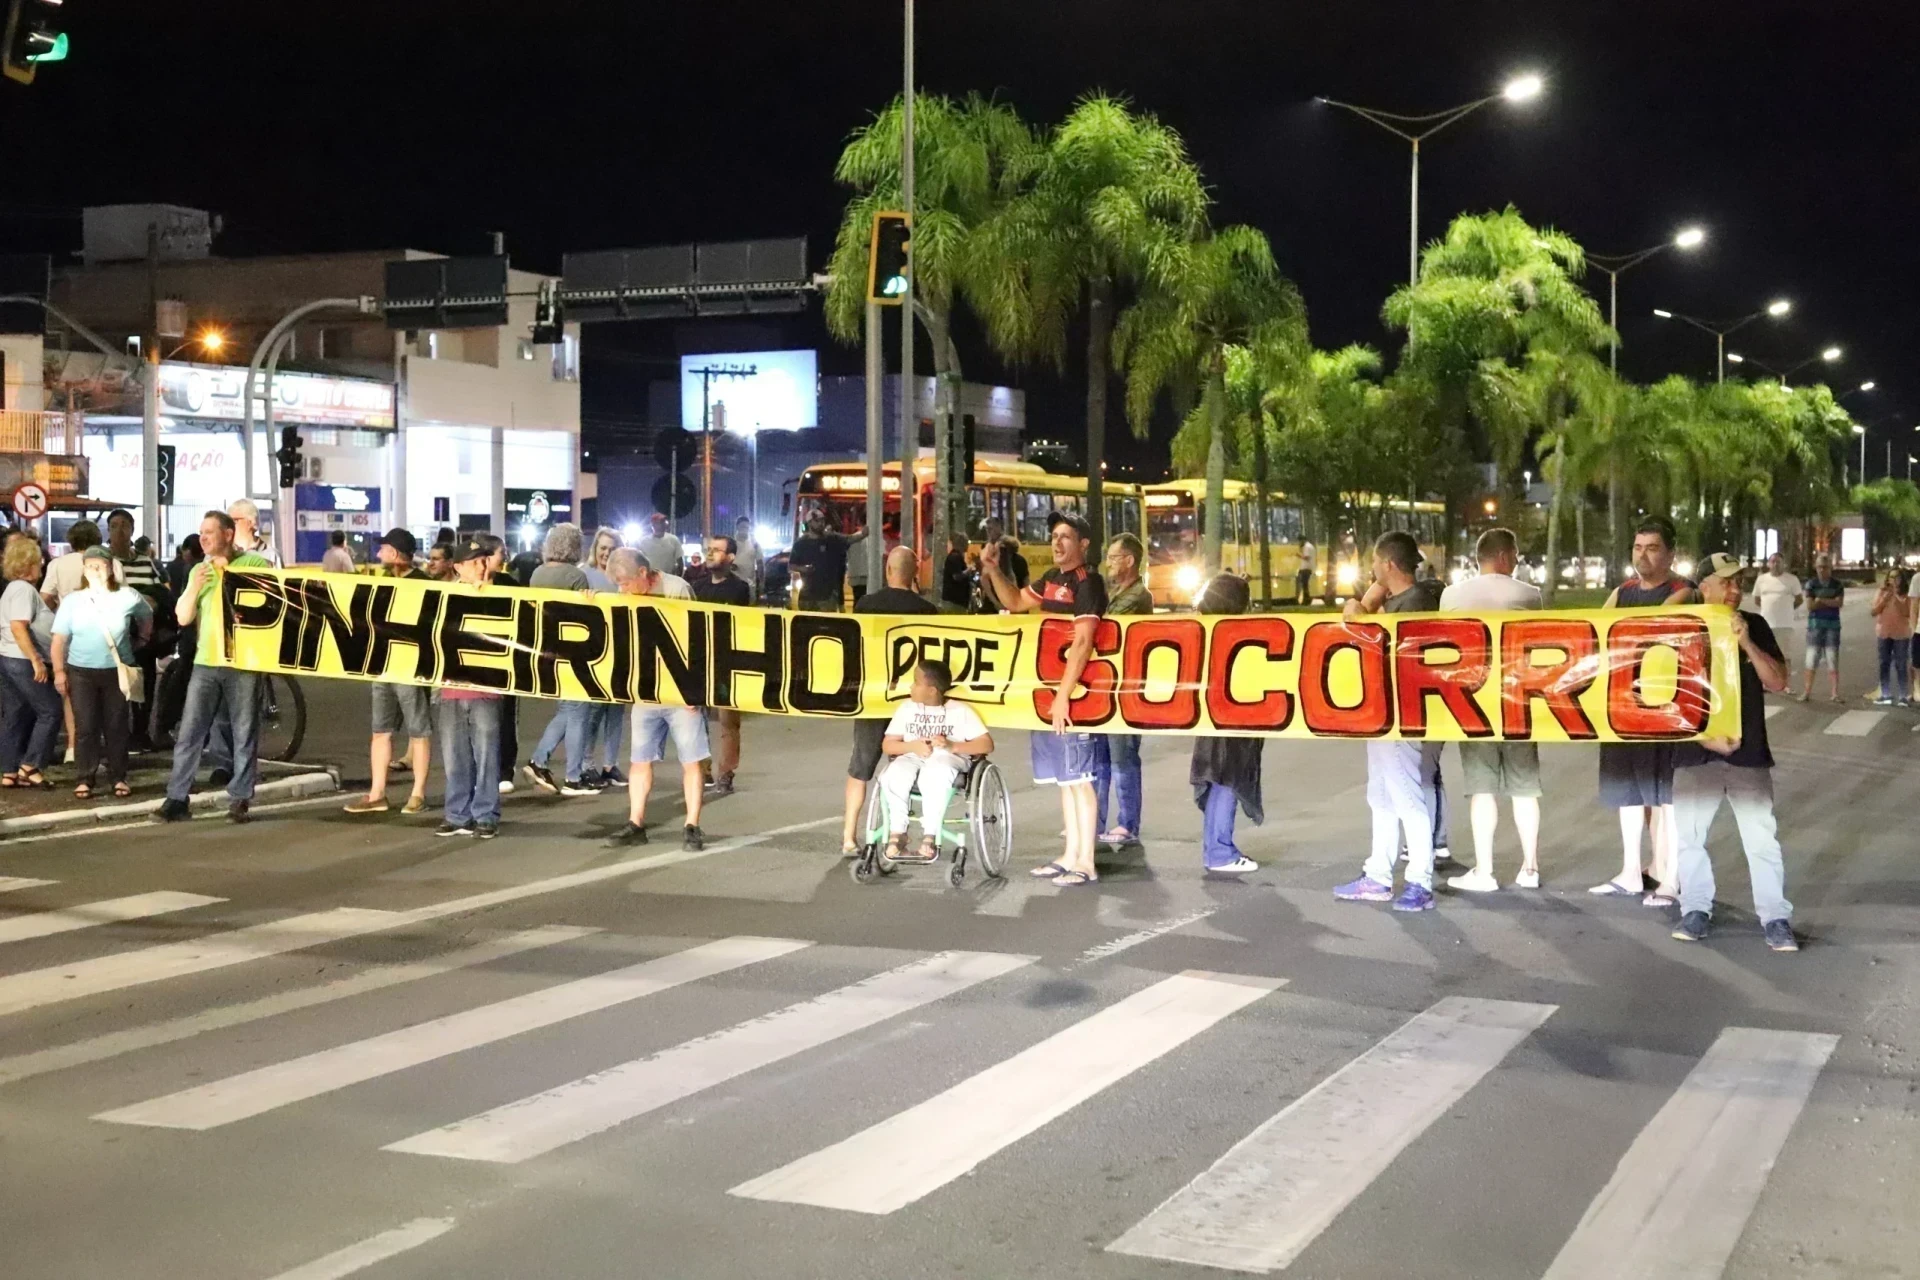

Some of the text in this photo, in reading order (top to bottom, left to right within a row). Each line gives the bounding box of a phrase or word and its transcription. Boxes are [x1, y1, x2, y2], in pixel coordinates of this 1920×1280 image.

[222, 570, 866, 717] PINHEIRINHO
[1032, 614, 1712, 740] SOCORRO
[914, 713, 945, 724] TOKYO
